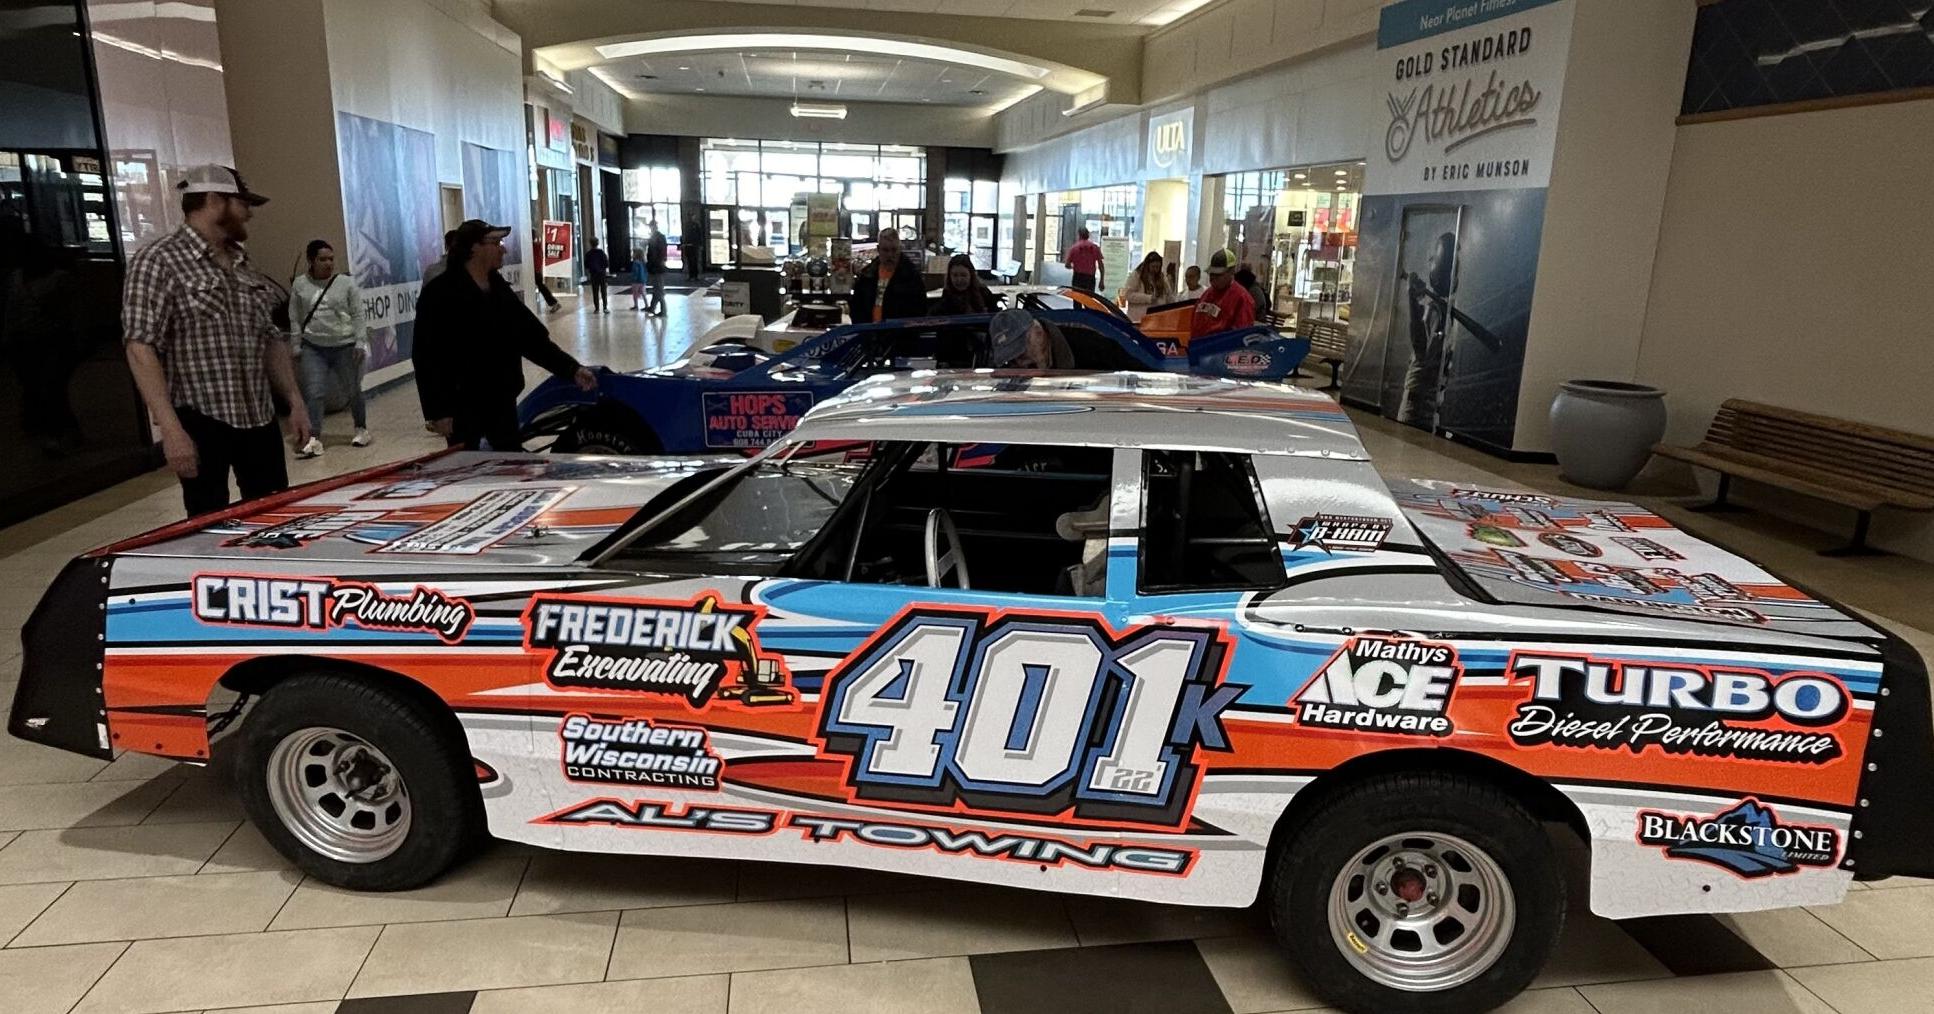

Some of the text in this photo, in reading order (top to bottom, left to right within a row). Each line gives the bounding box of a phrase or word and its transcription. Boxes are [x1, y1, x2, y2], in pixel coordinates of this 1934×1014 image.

[1420, 15, 1444, 30] Near
[1446, 3, 1478, 24] Planet
[1396, 27, 1532, 81] GOLD STANDARD
[1408, 70, 1542, 143] Athletics
[1156, 120, 1185, 154] ULTA
[1423, 160, 1530, 182] BY ERIC MUNSON
[709, 415, 747, 431] AUTO
[198, 576, 466, 633] CRIST Plumbing
[534, 603, 744, 652] FREDERICK
[1355, 639, 1449, 665] Mathys
[552, 644, 719, 700] Excavating
[1296, 648, 1456, 711] ACE
[1515, 656, 1842, 718] TURBO
[563, 719, 704, 748] Southern
[1302, 703, 1449, 731] Hardware
[1511, 705, 1834, 755] Diesel Performance
[565, 742, 719, 775] Wisconsin
[567, 766, 716, 787] CONTRACTING
[567, 802, 1188, 874] AL'S TOWING
[1642, 814, 1832, 852] BLACKSTONE
[1781, 851, 1830, 862] LIMITED
